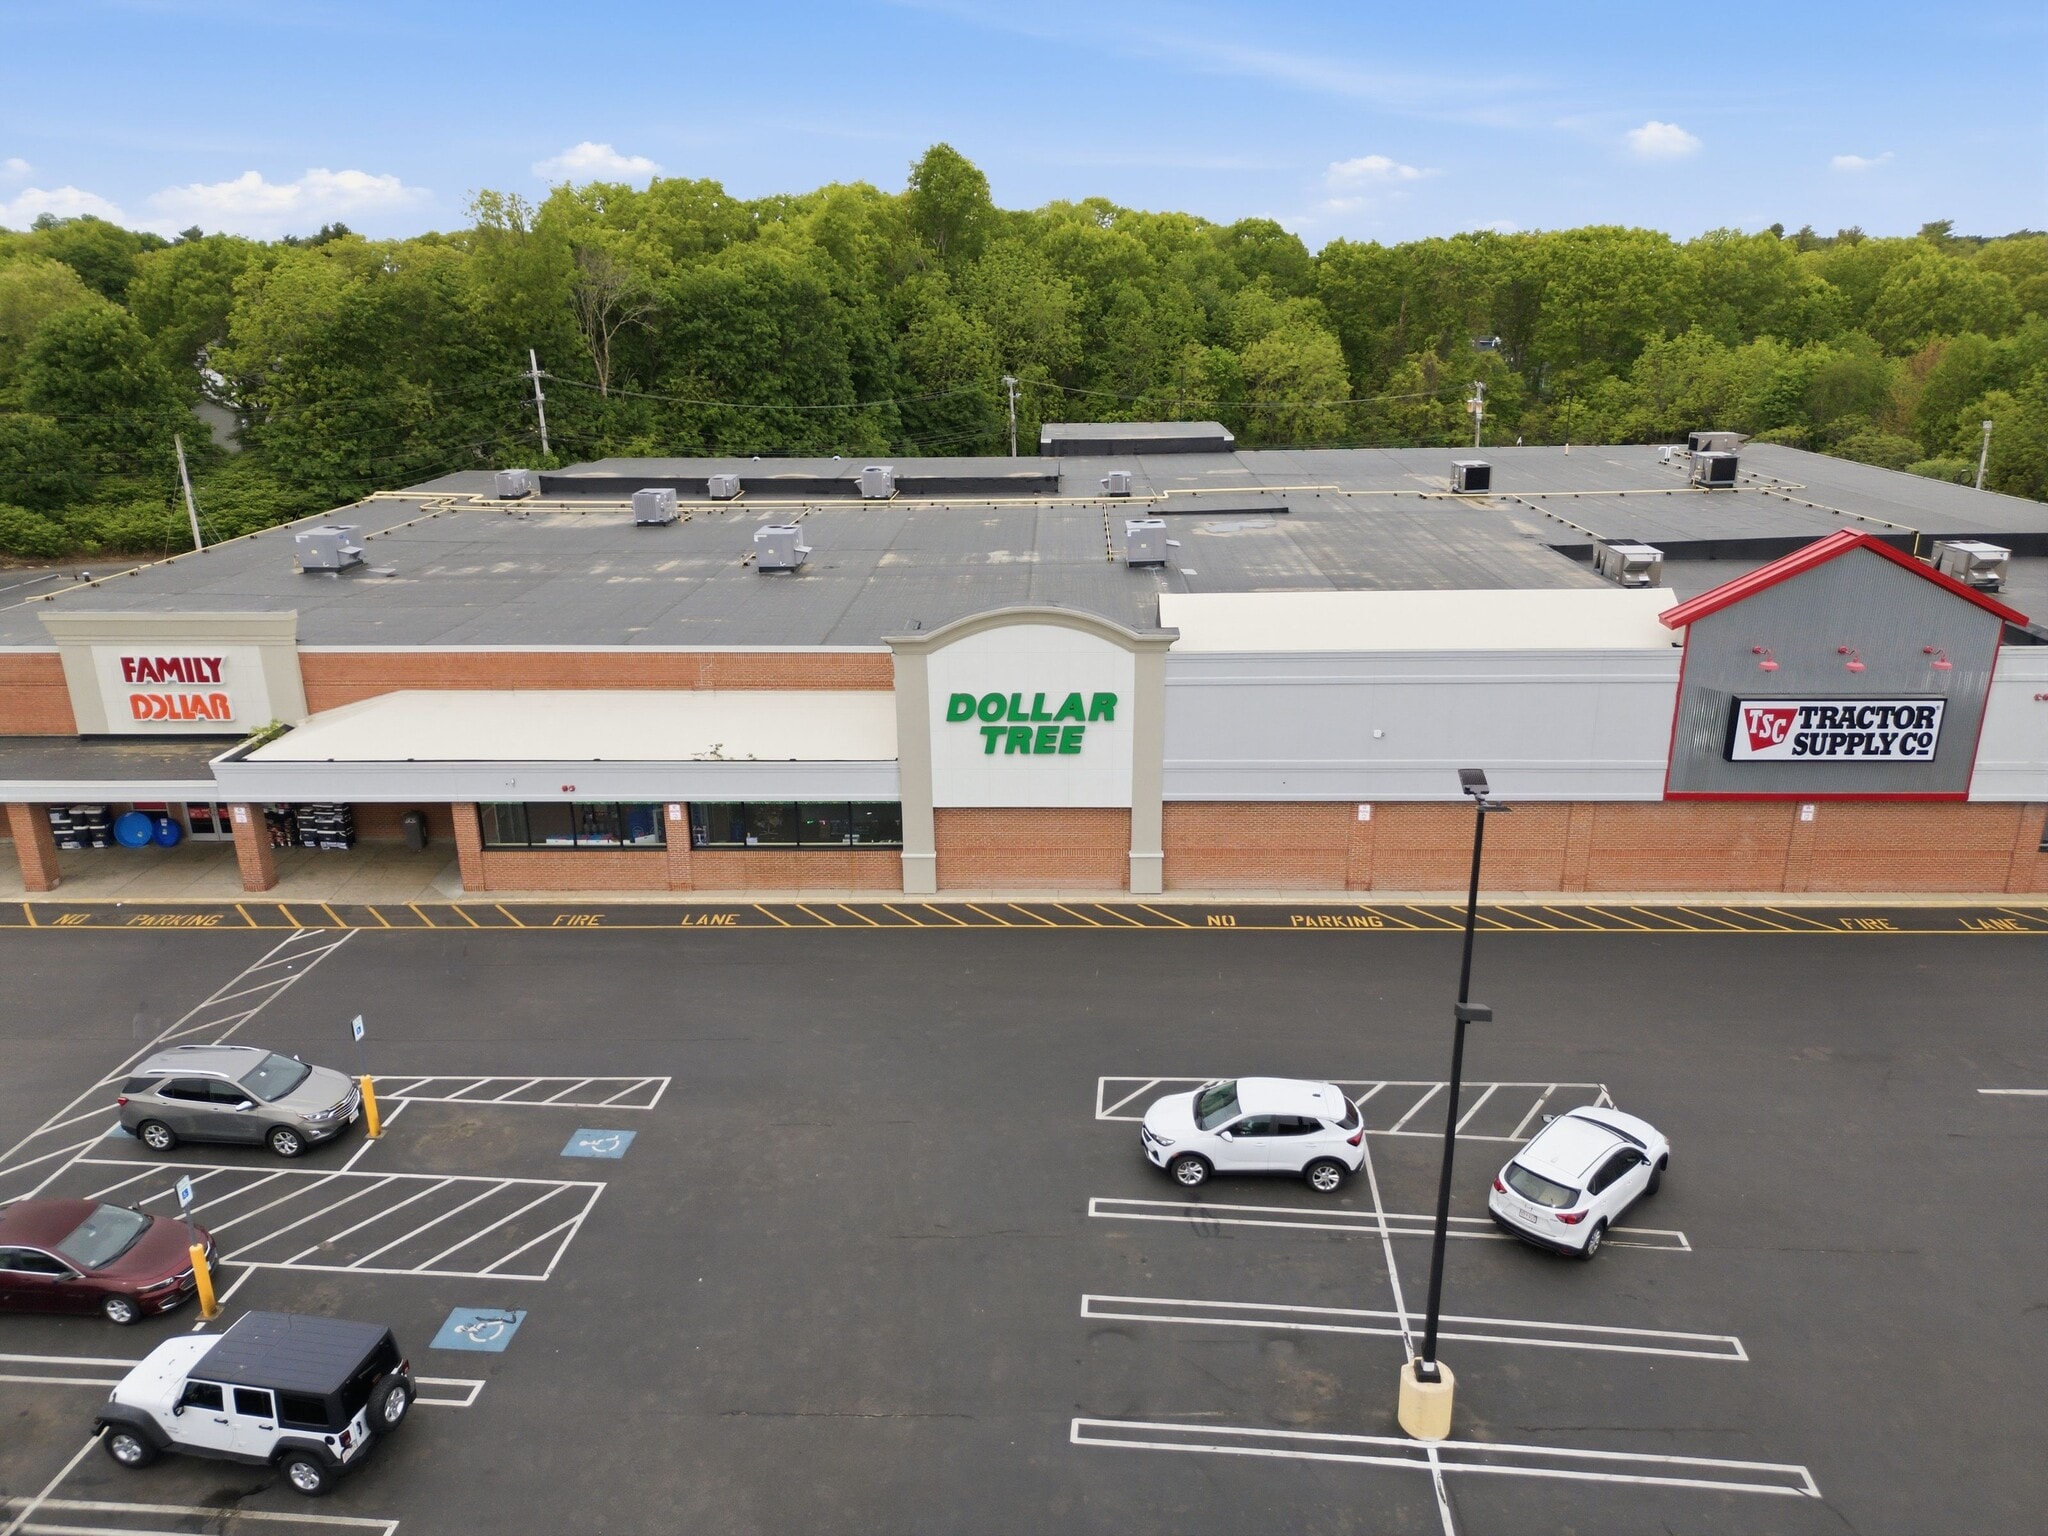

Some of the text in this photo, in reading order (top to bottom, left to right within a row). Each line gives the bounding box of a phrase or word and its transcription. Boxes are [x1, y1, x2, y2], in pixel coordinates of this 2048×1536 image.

[120, 657, 222, 683] FAMILY
[129, 693, 231, 720] DOLLAR
[946, 692, 1118, 722] DOLLAR
[1798, 705, 1936, 729] TRACTOR
[1749, 709, 1787, 744] TSC
[979, 725, 1086, 755] TREE
[1791, 732, 1899, 756] SUPPLY
[52, 913, 224, 926] NO PARKING
[552, 913, 741, 926] FIRE LANE
[1207, 914, 1384, 927] NO PARKING
[1838, 918, 2029, 930] FIRE LANE
